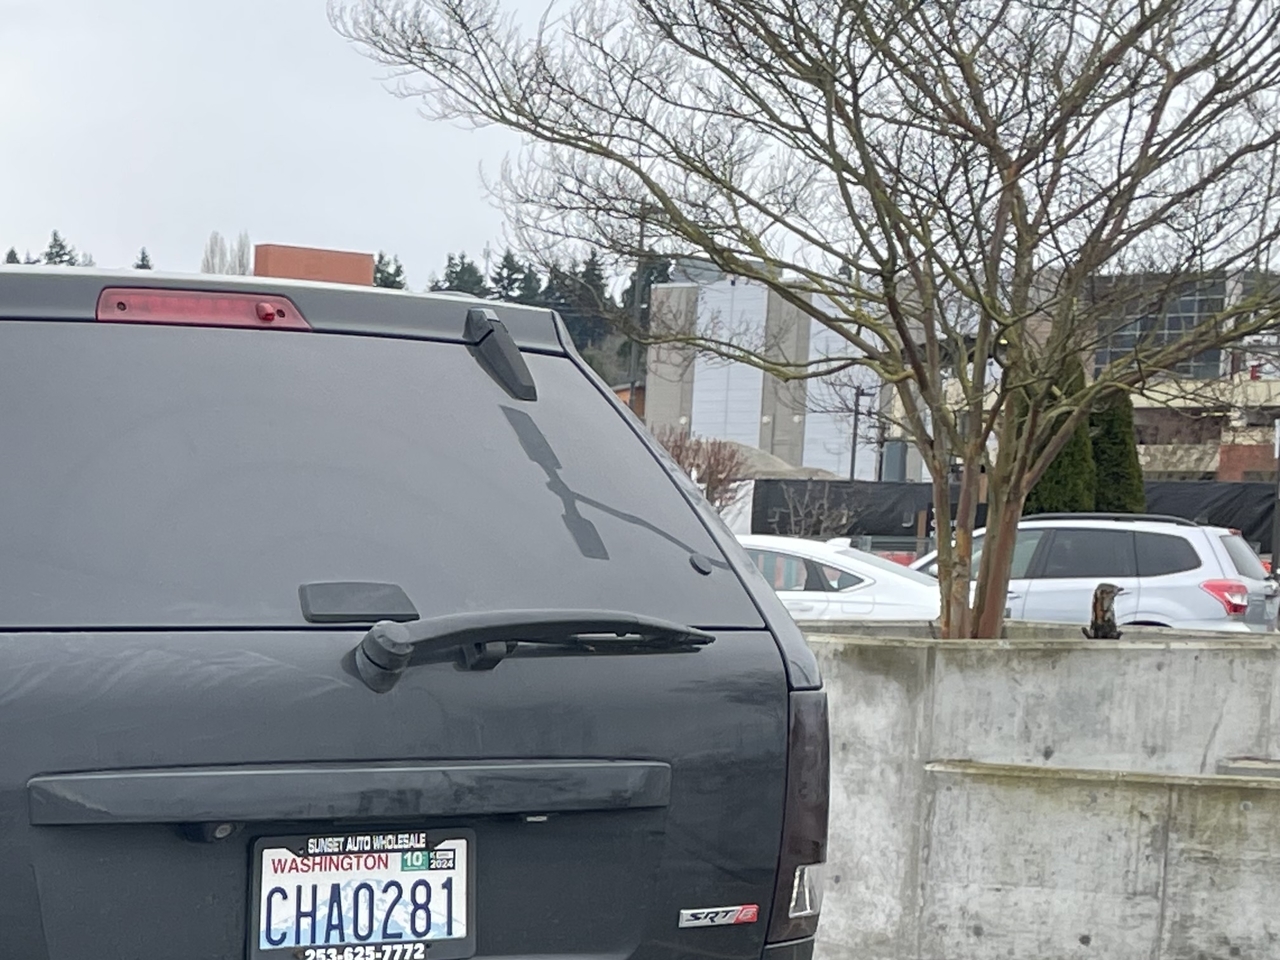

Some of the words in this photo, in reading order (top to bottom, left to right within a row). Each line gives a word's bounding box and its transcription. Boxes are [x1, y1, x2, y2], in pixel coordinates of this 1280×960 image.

[308, 837, 343, 854] SUNSET
[346, 835, 370, 851] AUTO
[373, 833, 426, 850] WHOLESALE
[272, 853, 389, 874] WASHINGTON
[404, 851, 423, 866] 10
[430, 860, 453, 869] 2024
[265, 876, 453, 946] CHA0281
